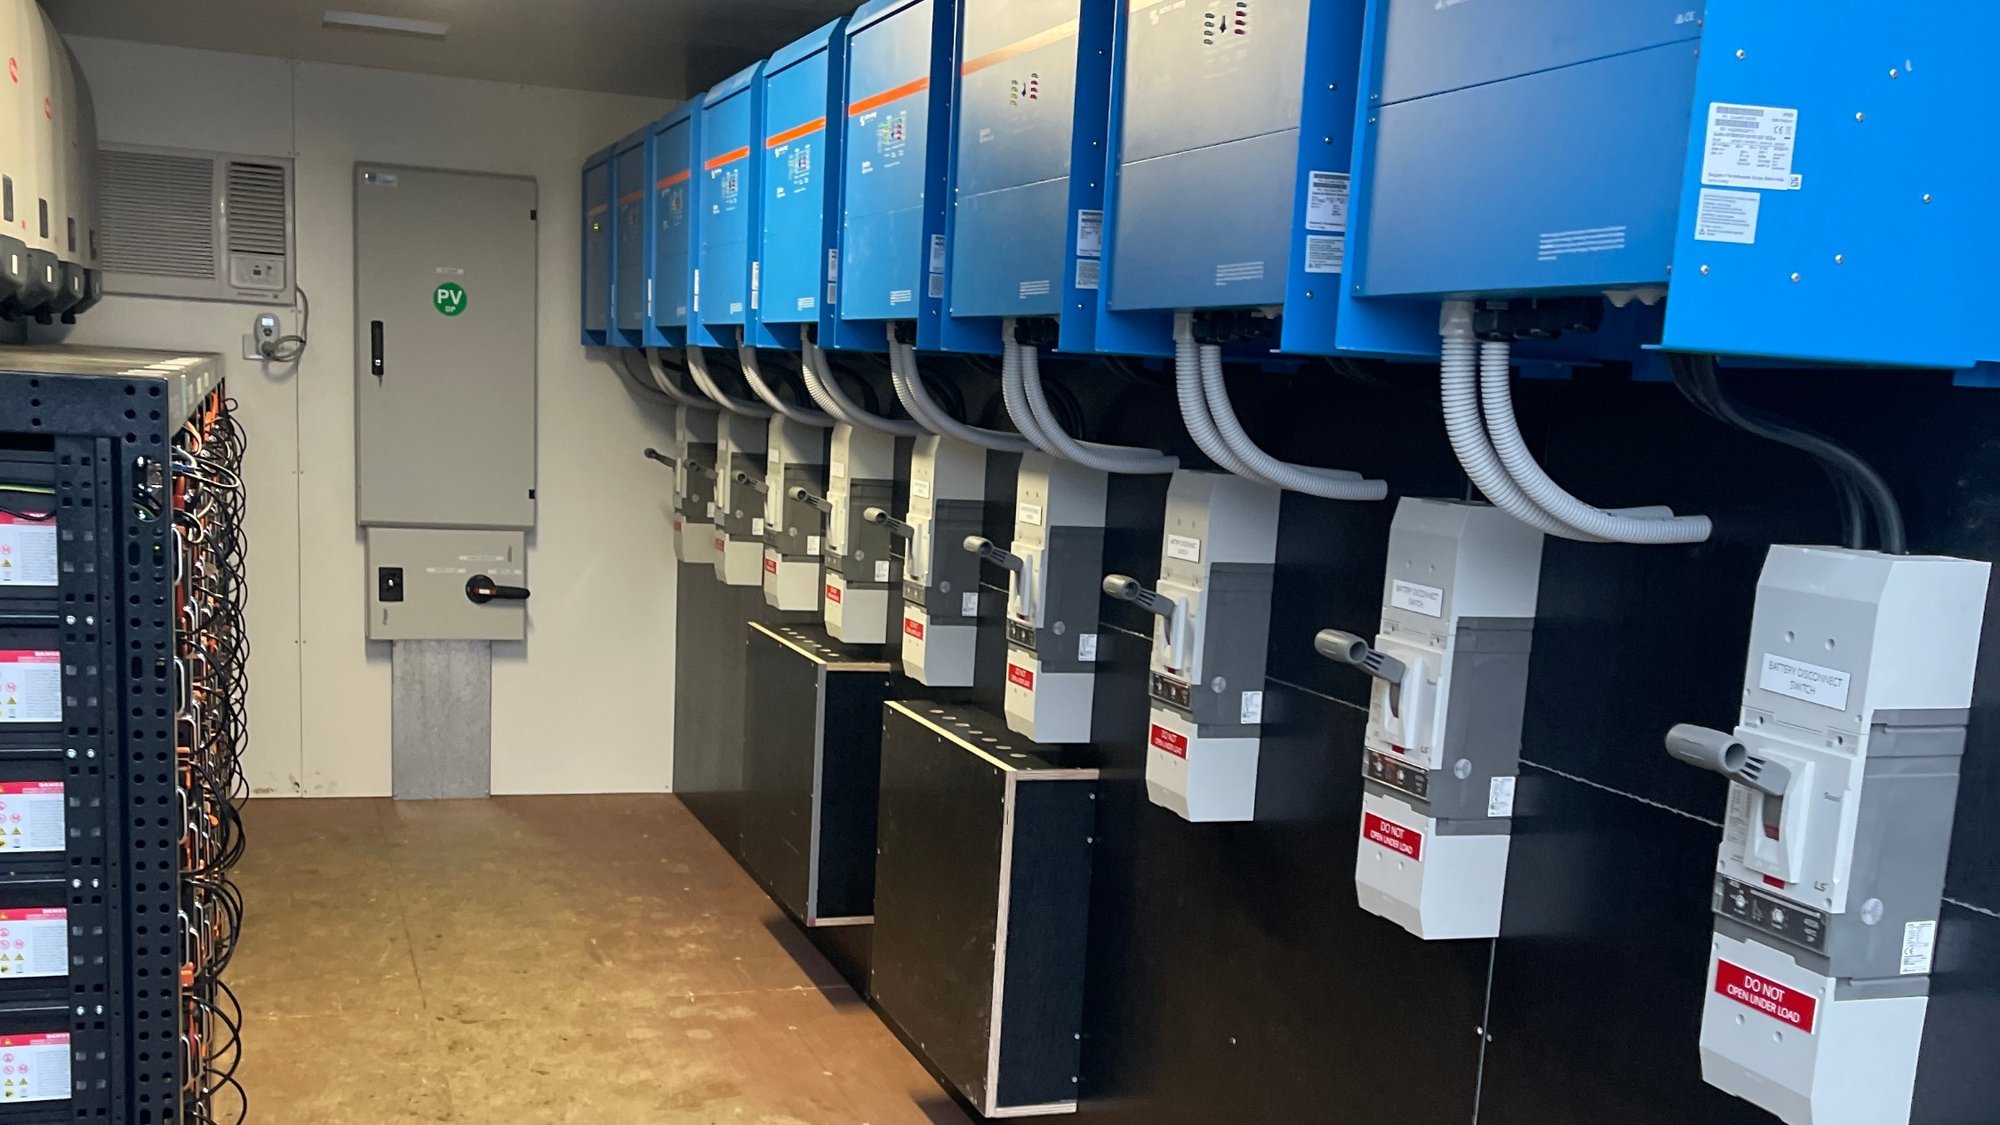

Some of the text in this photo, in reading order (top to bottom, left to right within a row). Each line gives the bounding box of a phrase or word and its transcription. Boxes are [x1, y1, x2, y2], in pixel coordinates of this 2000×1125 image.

[437, 288, 463, 305] PV
[1768, 660, 1843, 687] BATTERY DISCONNECT
[1789, 680, 1816, 695] SWITCH
[1380, 820, 1405, 839] DO NOT
[1370, 829, 1413, 855] OPEN UNDER LOAD
[1814, 881, 1828, 893] LS
[1744, 975, 1786, 1003] DO NOT
[1727, 983, 1801, 1024] OPEN UNDER LOAD
